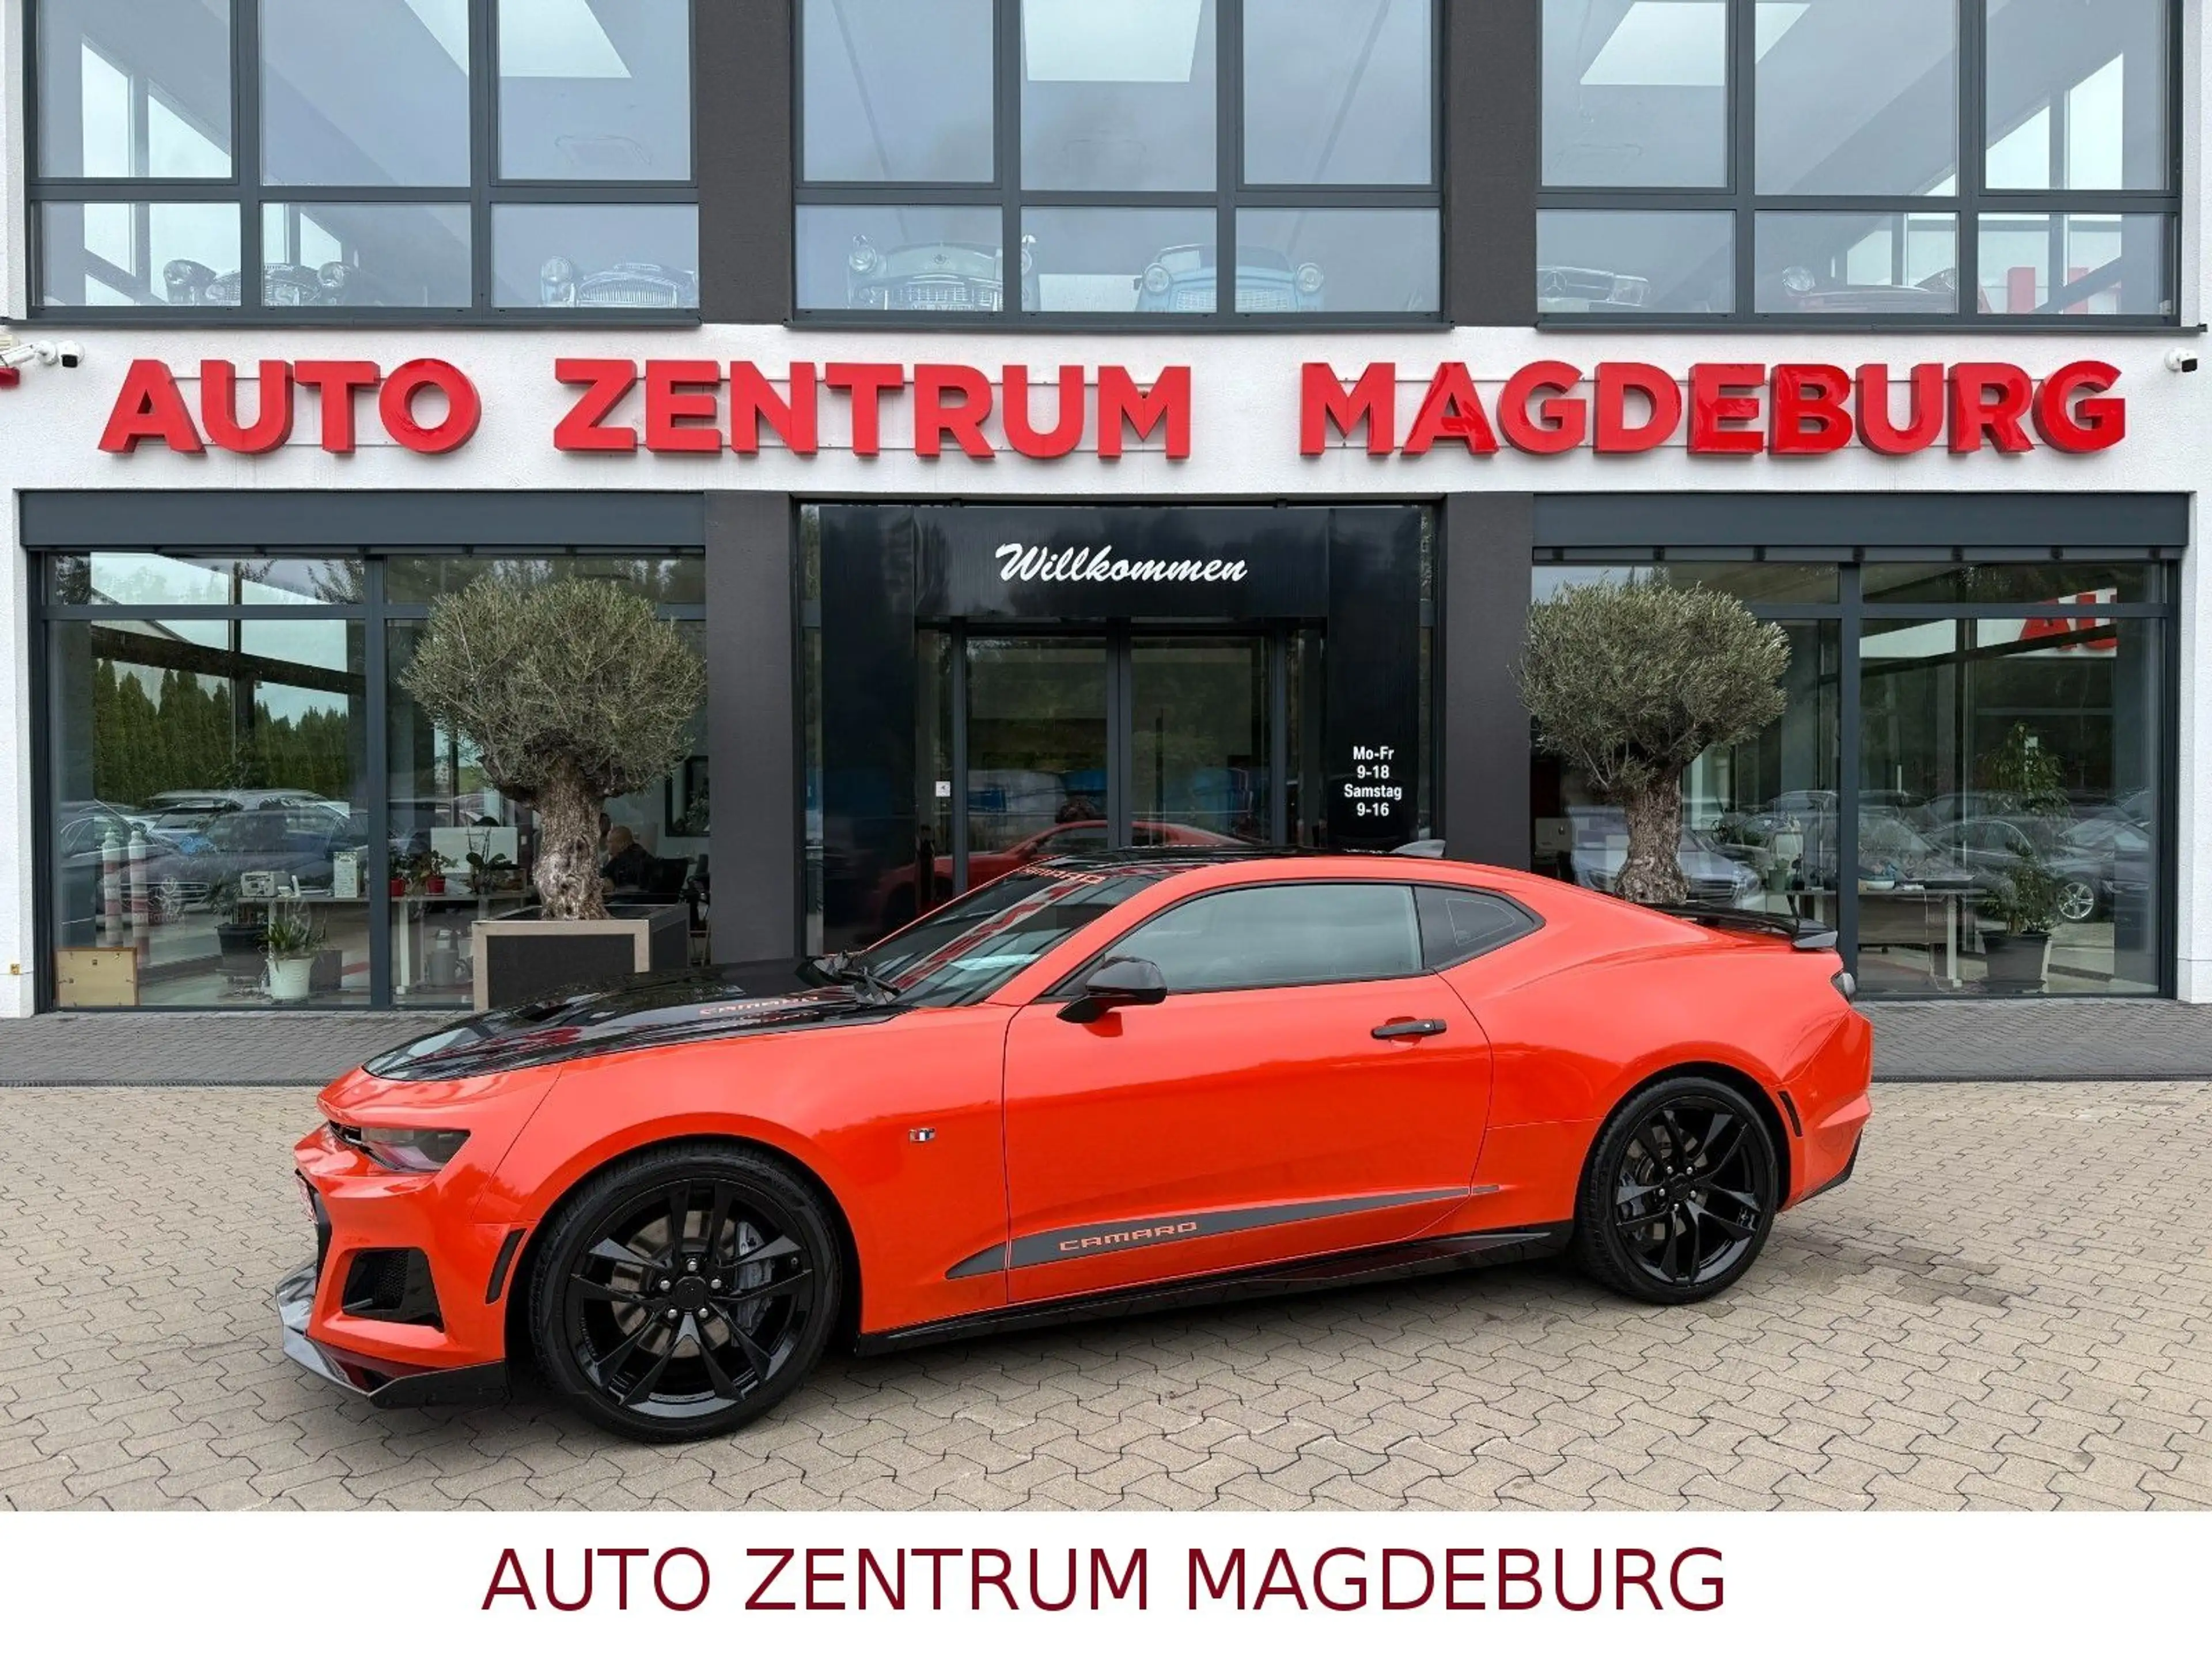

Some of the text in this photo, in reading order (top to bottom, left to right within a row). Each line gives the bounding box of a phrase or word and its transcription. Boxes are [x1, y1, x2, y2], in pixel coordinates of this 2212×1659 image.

[99, 358, 2126, 460] AUTO ZENTRUM MAGDEBURG
[995, 543, 1248, 582] Willkommen
[1353, 745, 1395, 760] Mo-Fr
[1357, 764, 1389, 779] 9-18
[1344, 783, 1402, 801] Samstag
[1357, 802, 1389, 817] 9-16
[1059, 1221, 1197, 1251] CAMARO
